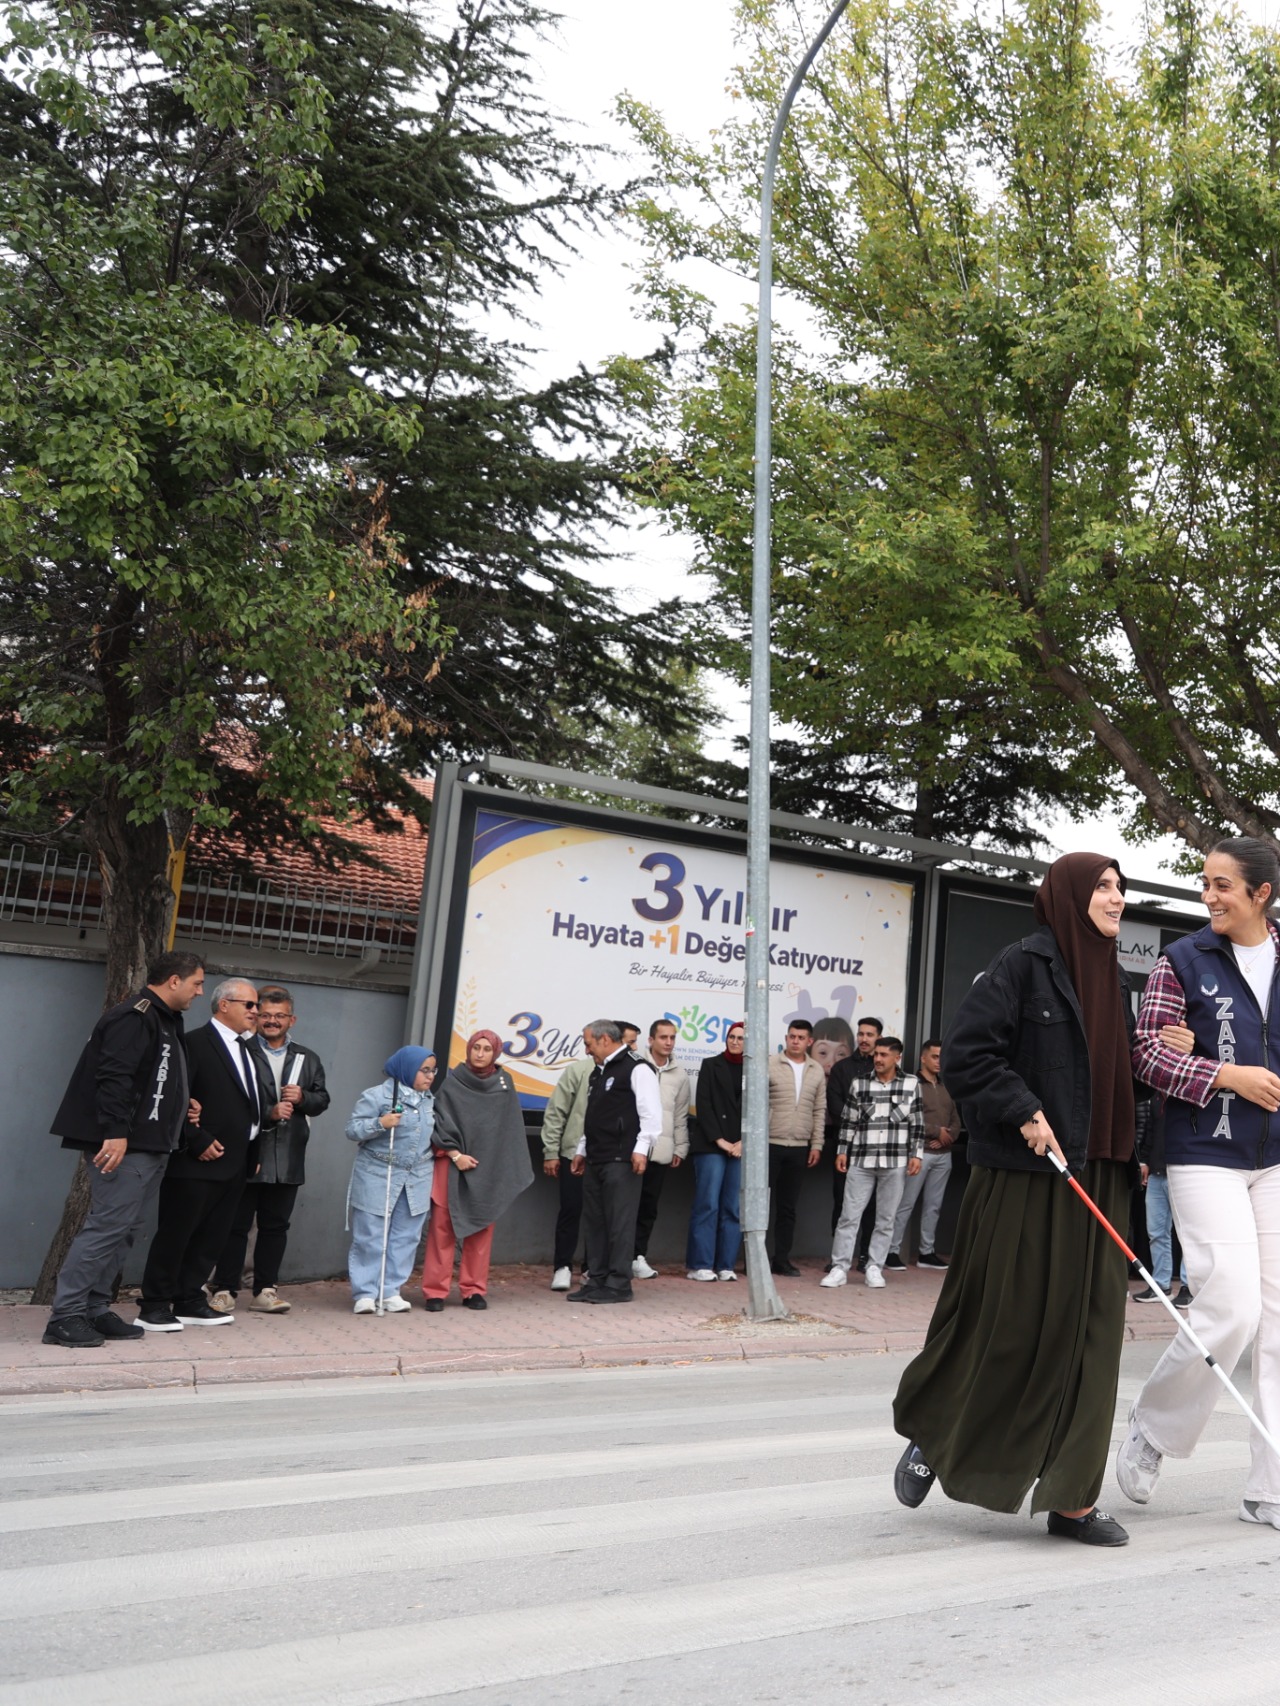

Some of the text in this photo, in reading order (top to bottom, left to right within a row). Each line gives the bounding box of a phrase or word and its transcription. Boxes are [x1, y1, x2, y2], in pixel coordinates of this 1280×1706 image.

[631, 851, 798, 932] 3 Yılır
[552, 911, 644, 948] Hayata
[648, 924, 680, 955] +1
[684, 931, 748, 964] Değe
[1115, 940, 1154, 957] LAK
[629, 962, 648, 976] Bir
[650, 964, 693, 983] Hayalin
[697, 970, 738, 989] Büyüyen
[1212, 997, 1236, 1139] ZABTA
